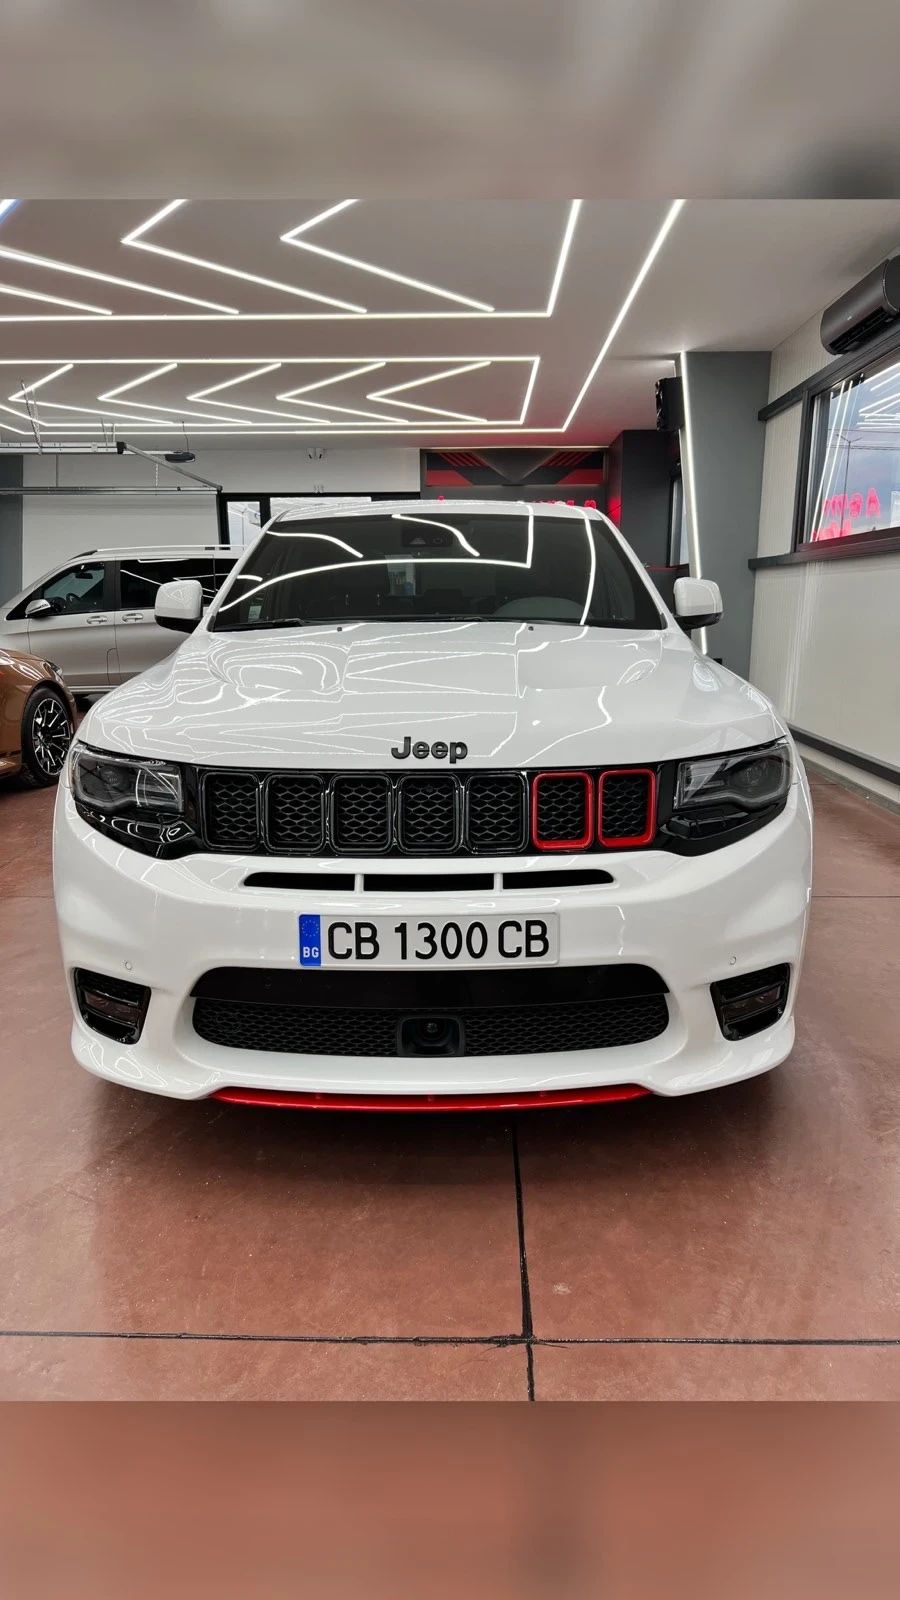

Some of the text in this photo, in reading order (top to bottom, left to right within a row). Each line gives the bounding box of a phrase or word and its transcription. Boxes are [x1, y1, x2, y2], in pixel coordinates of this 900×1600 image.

[391, 736, 468, 764] Jeep
[302, 946, 319, 958] BG
[327, 919, 550, 960] CB 1300 CB
